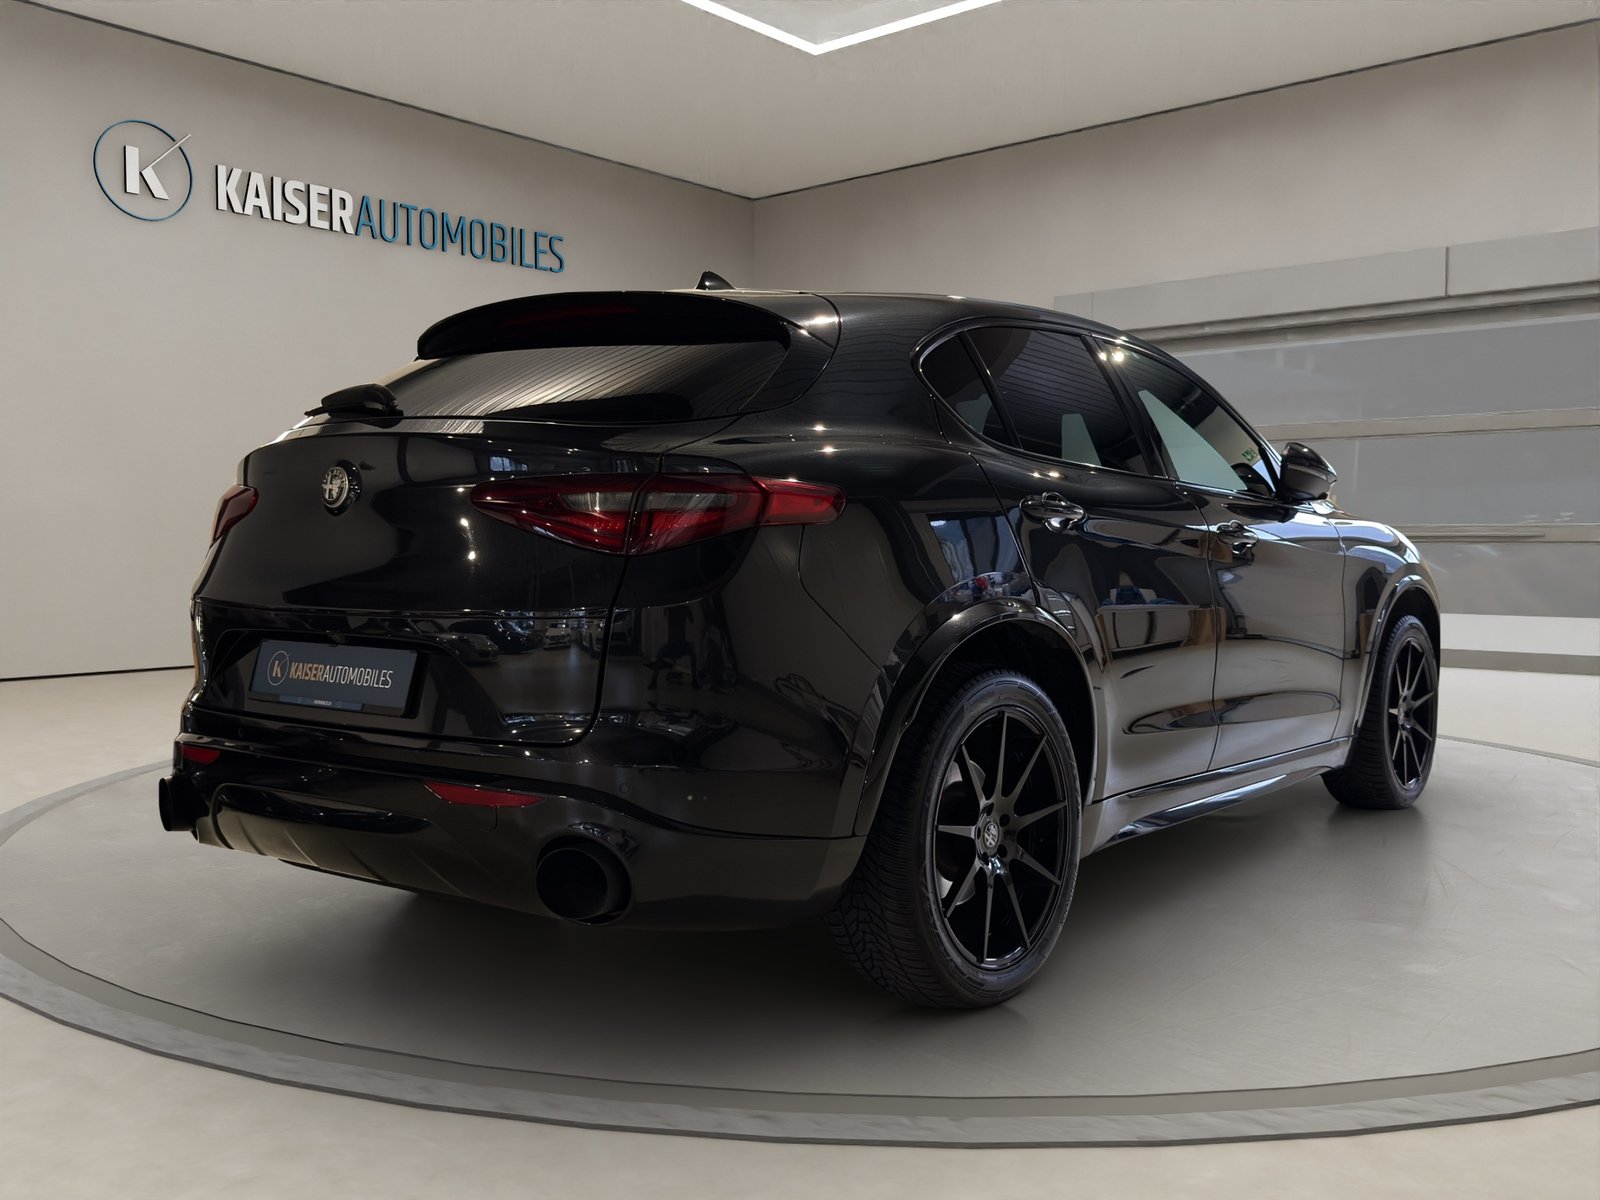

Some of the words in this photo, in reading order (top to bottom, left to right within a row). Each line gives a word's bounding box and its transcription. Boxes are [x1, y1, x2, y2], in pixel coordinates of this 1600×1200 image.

[123, 133, 192, 200] K
[214, 164, 566, 274] KAISERAUTOMOBILES
[289, 661, 394, 689] KAISERAUTOMOBILES
